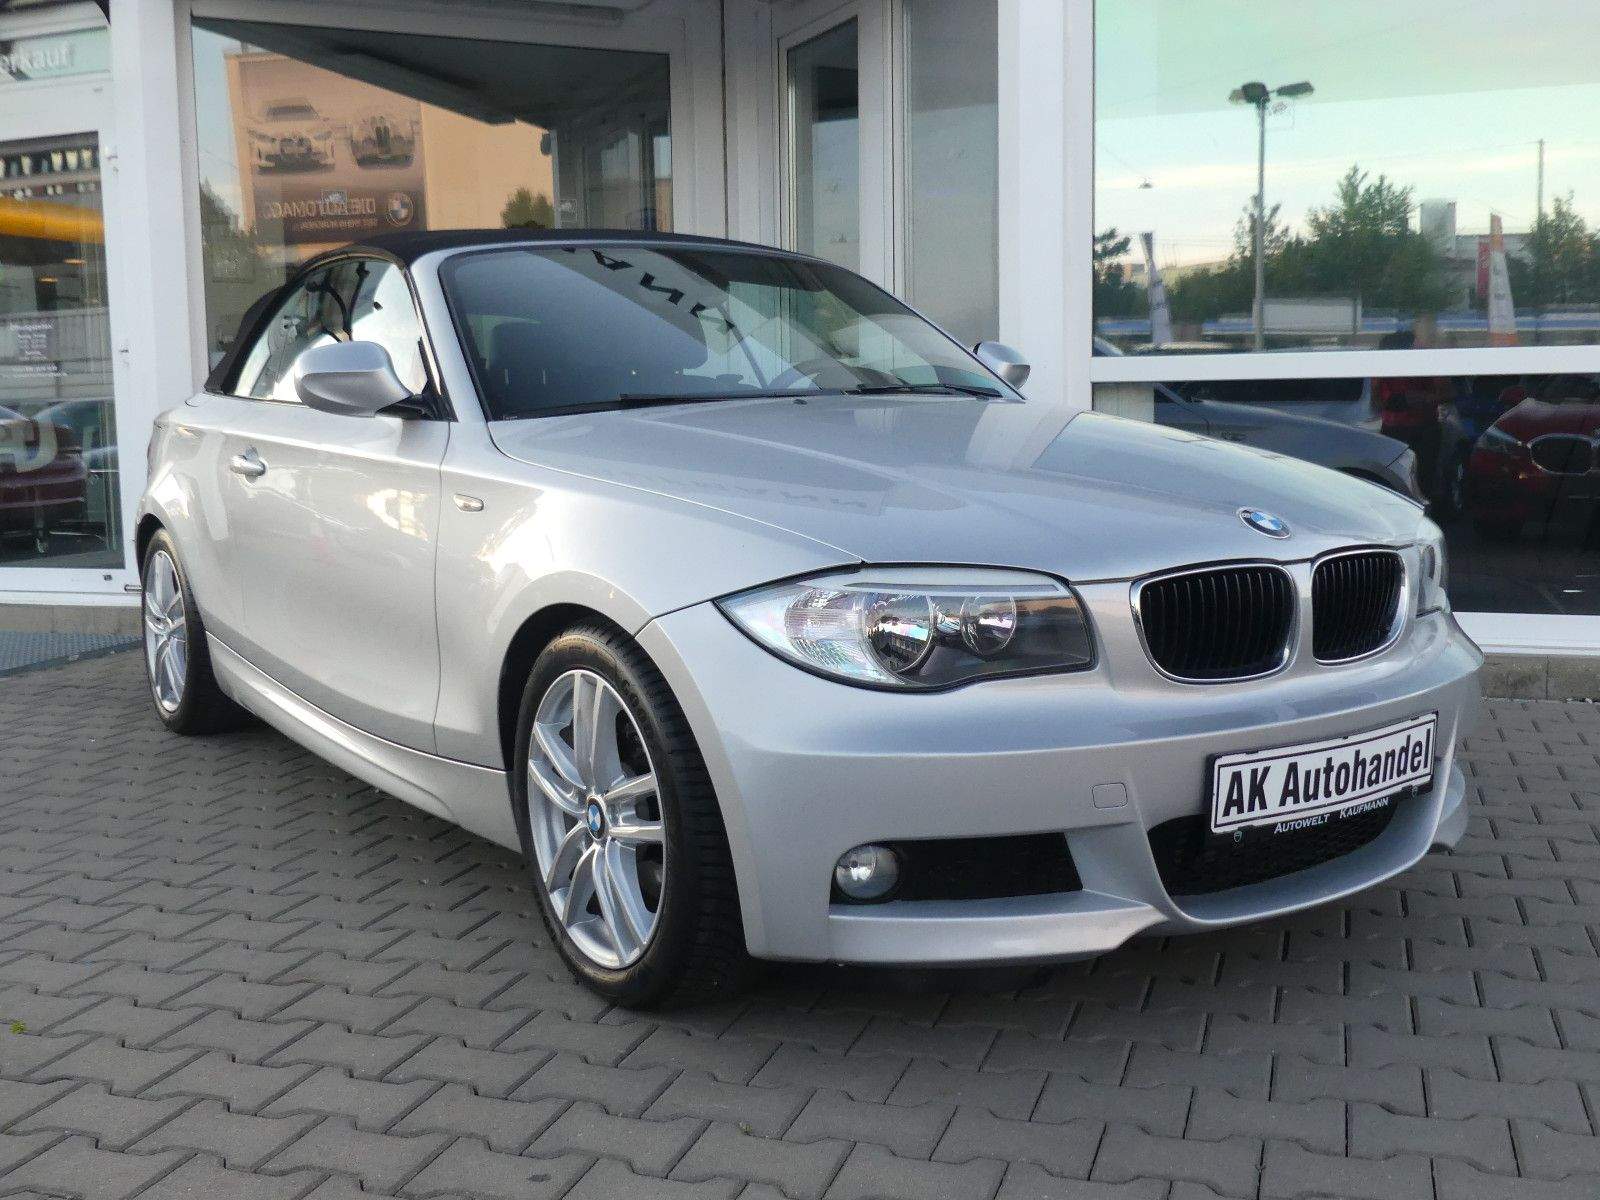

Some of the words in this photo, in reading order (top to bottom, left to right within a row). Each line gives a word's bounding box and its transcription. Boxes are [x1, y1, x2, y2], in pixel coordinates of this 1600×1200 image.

[1222, 766, 1271, 817] AK
[1279, 728, 1431, 807] Autohandel
[1273, 813, 1330, 834] AUTOWELT
[1340, 797, 1390, 819] KAUFMANN
